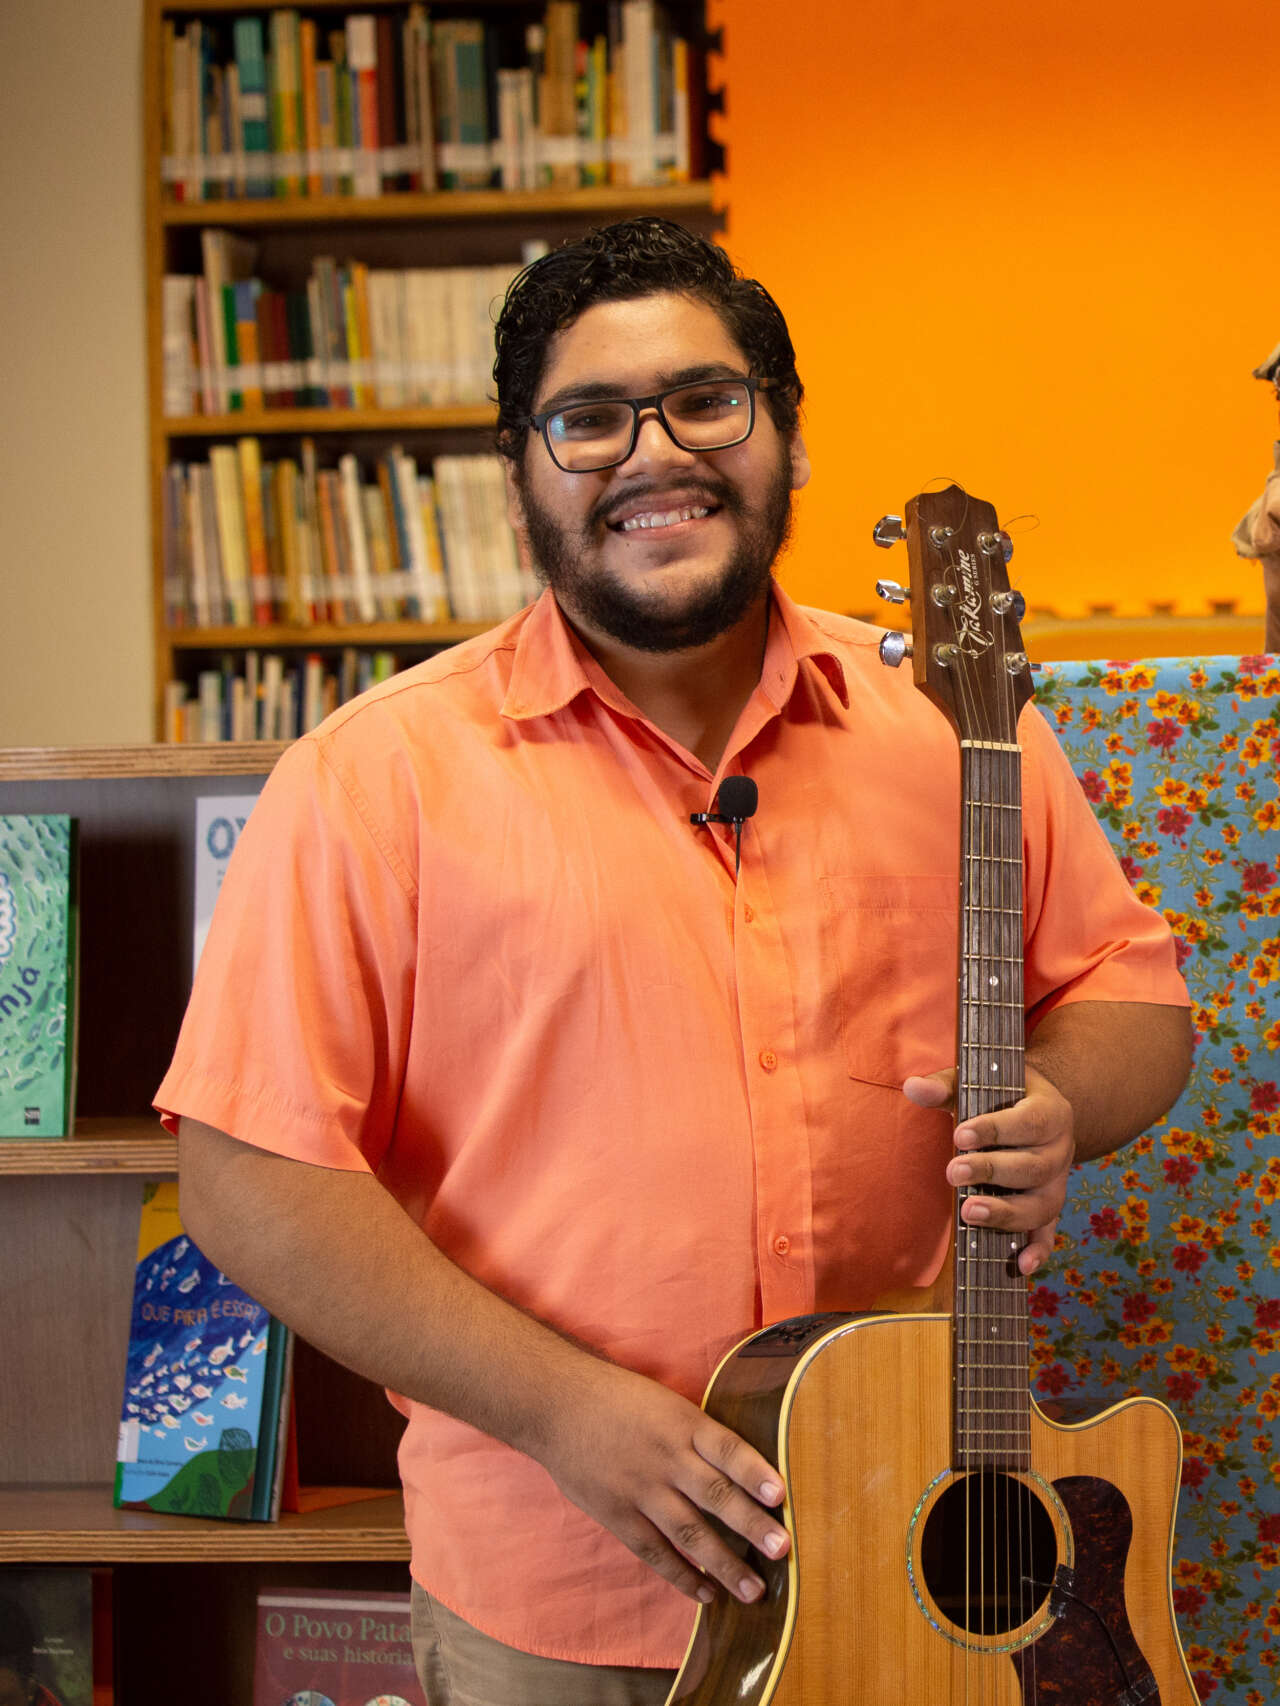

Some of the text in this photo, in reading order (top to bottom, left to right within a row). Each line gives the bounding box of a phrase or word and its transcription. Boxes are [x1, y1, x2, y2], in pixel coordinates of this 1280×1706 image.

[970, 553, 979, 580] SERIES
[958, 549, 995, 659] Takamine
[0, 965, 41, 1022] njá
[141, 1302, 171, 1322] QUE
[265, 1612, 411, 1642] O Povo Pata
[283, 1647, 294, 1660] e
[298, 1647, 338, 1662] suas
